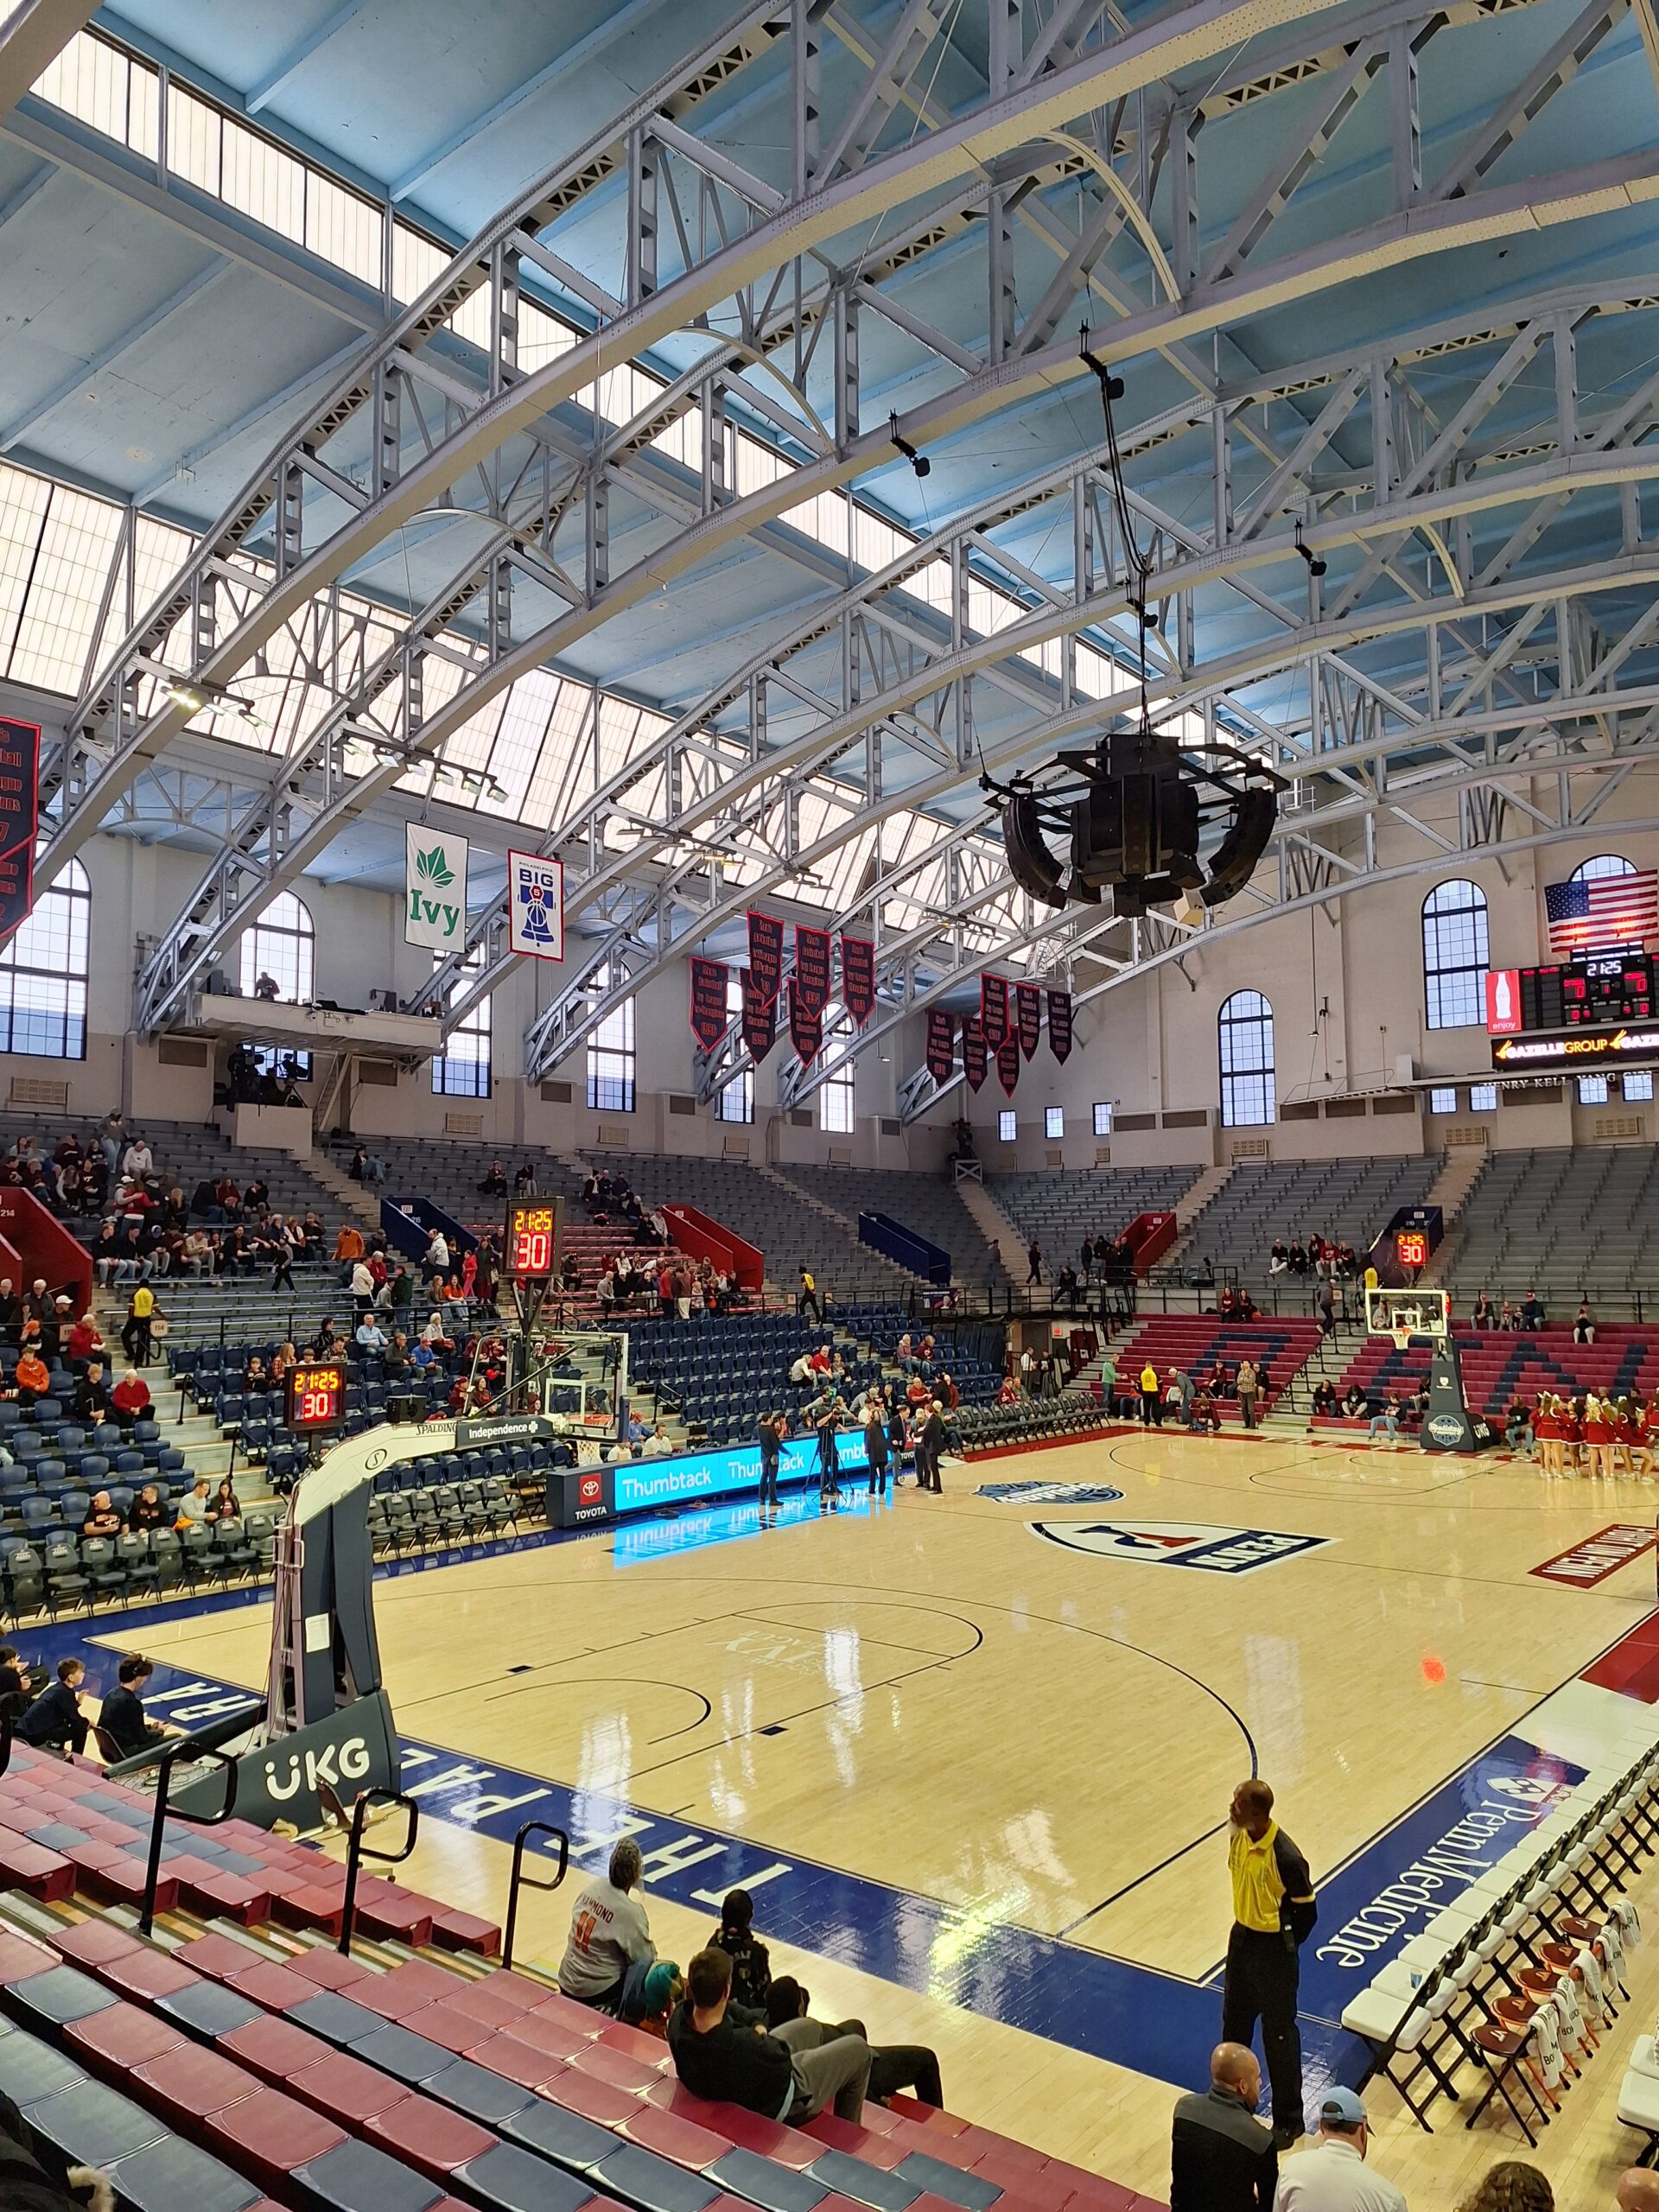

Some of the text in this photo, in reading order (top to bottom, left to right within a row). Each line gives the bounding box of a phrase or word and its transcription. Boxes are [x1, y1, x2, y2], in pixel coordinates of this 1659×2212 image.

[519, 861, 553, 873] PHILADELPHIA
[519, 868, 554, 887] BIG
[533, 888, 541, 897] 5
[410, 888, 460, 936] Ivy
[1586, 960, 1622, 976] 21:25
[1492, 1020, 1516, 1031] enjoy
[1534, 1077, 1570, 1089] KELL
[514, 1211, 552, 1231] 21:25
[1398, 1235, 1424, 1245] 21:25
[518, 1233, 547, 1269] 30
[1402, 1245, 1422, 1262] 30
[295, 1371, 339, 1392] 21:25
[304, 1393, 328, 1418] 30
[468, 1423, 528, 1439] Independence
[900, 1451, 915, 1460] TOYO
[622, 1467, 712, 1499] Thumbtack
[575, 1506, 607, 1521] TOYOTA
[1186, 1534, 1309, 1570] PENN
[1541, 1553, 1622, 1579] PENN
[581, 1894, 614, 1924] HAMMOND
[573, 1910, 596, 1955] 11
